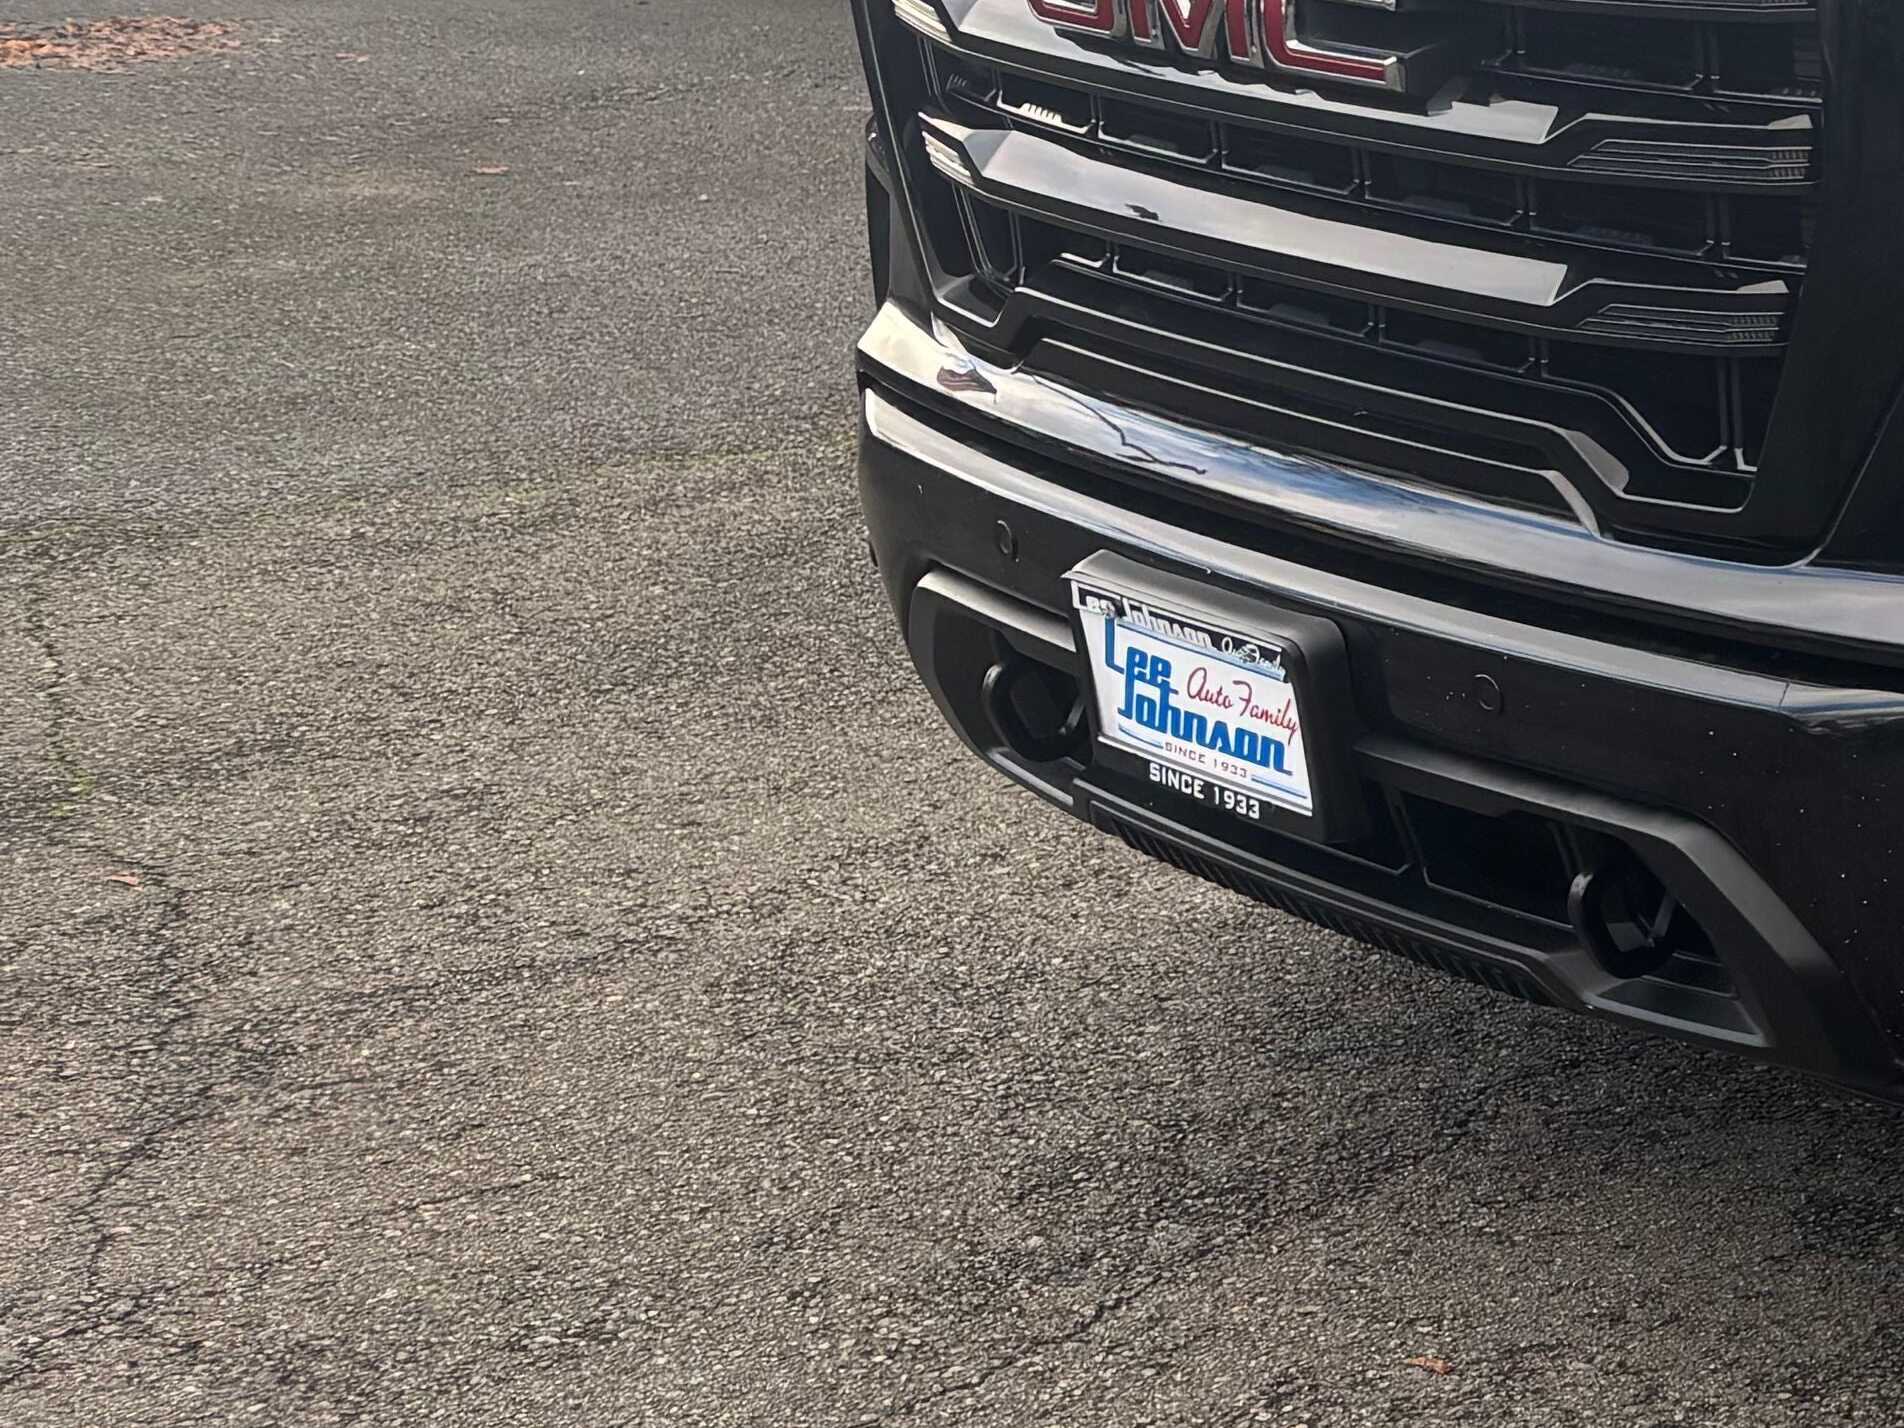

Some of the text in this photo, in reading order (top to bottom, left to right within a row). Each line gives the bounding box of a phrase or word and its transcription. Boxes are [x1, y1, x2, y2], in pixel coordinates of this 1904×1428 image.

[1104, 615, 1181, 696] Lee
[1116, 668, 1293, 777] Johnson
[1186, 667, 1299, 746] Auto Family
[1149, 762, 1260, 820] SINCE 1933
[1164, 740, 1248, 779] SINCE 1933
